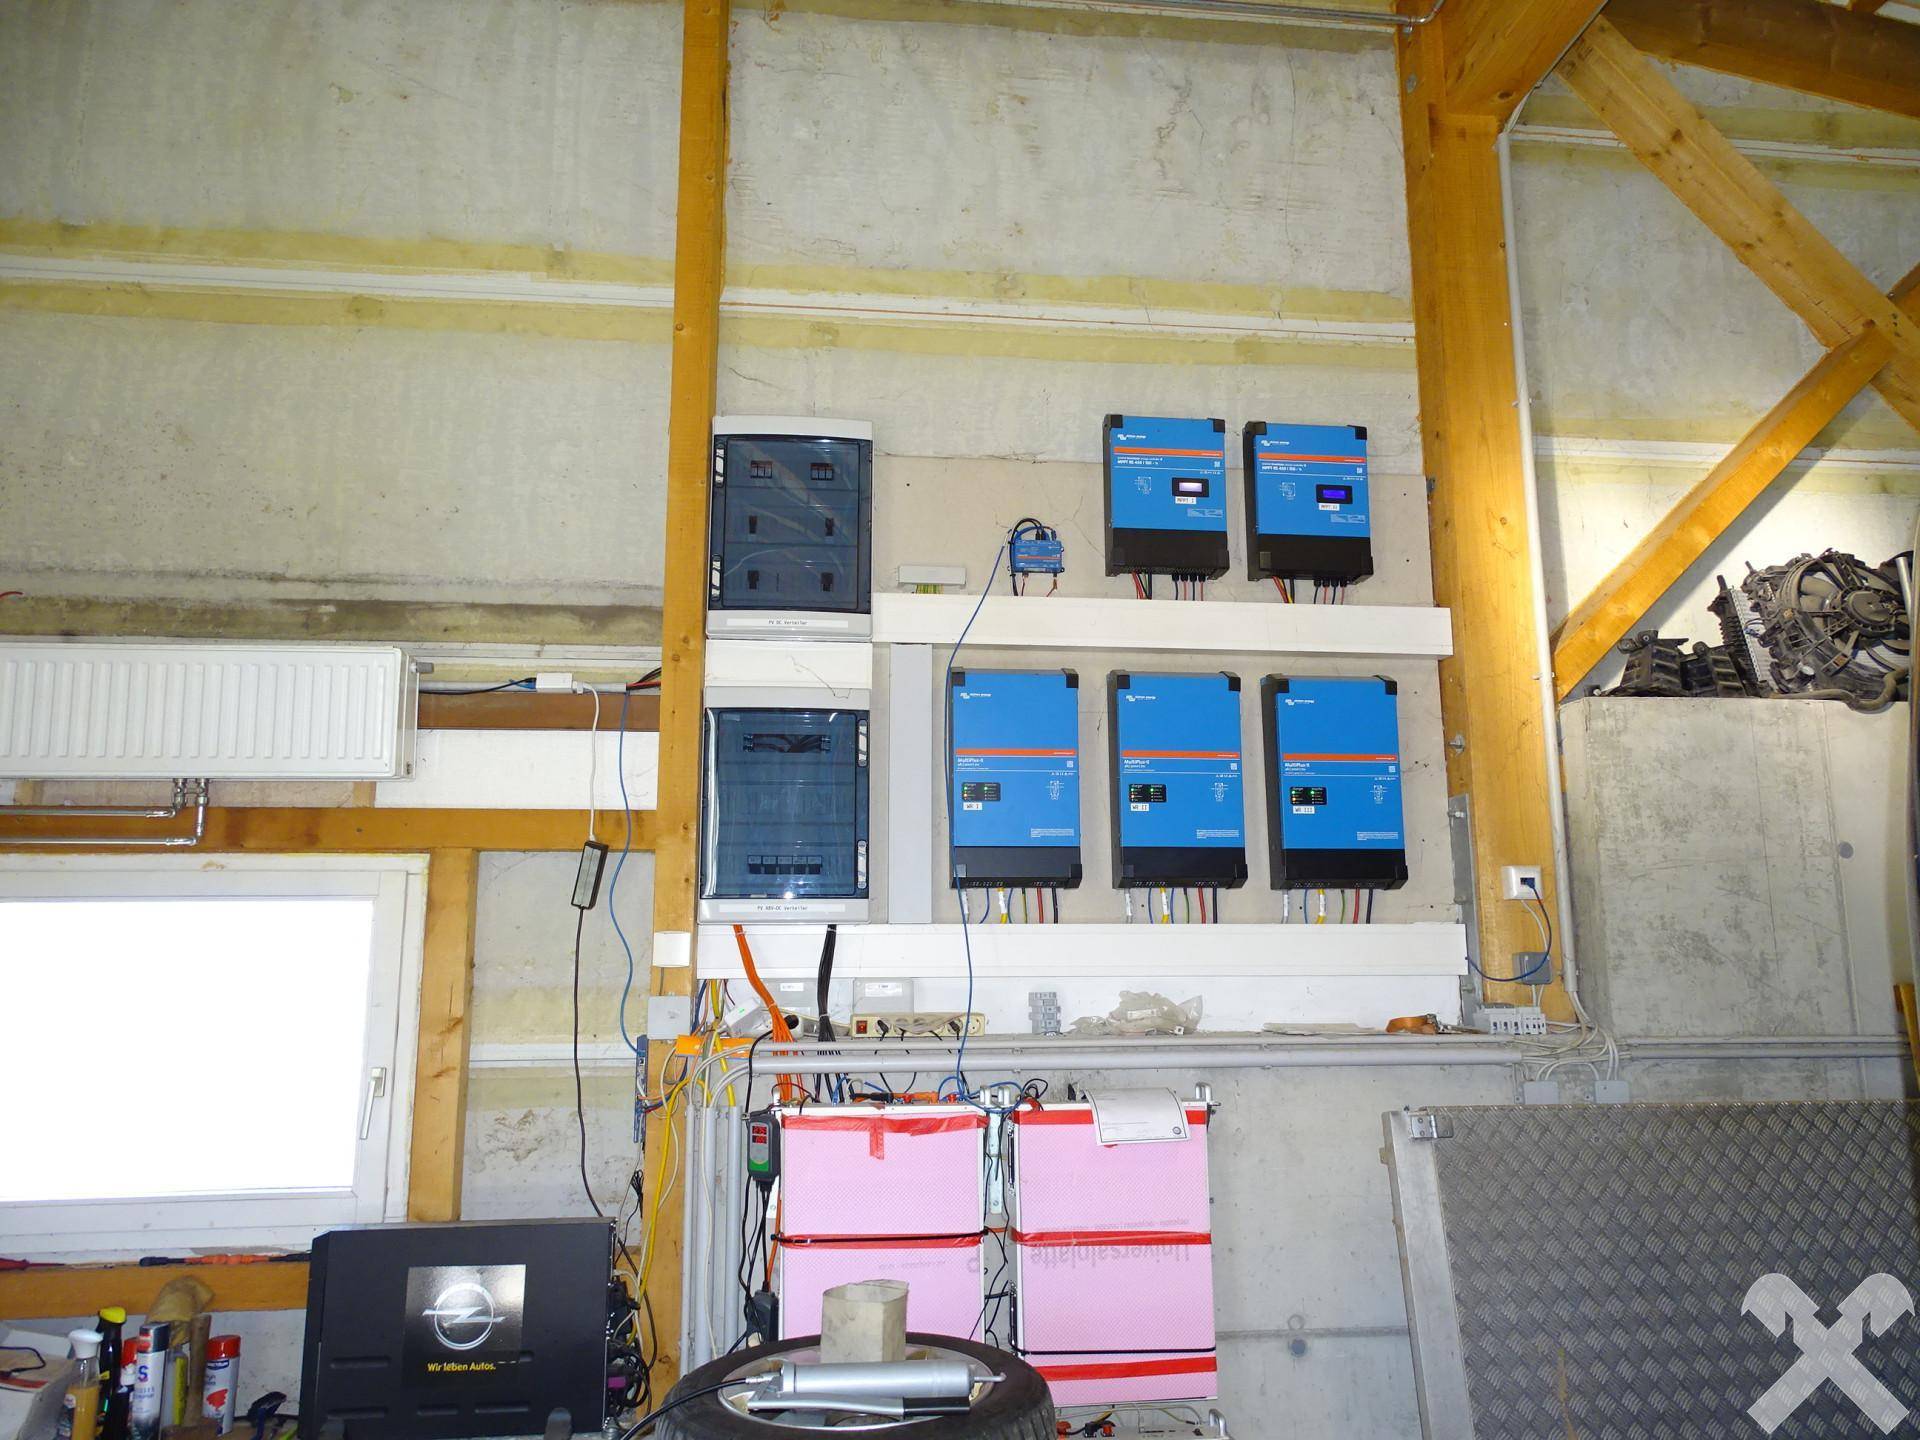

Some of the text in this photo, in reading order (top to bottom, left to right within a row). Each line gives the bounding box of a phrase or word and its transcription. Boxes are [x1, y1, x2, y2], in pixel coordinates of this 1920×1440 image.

[427, 1361, 497, 1371] Wir leben Autos.
